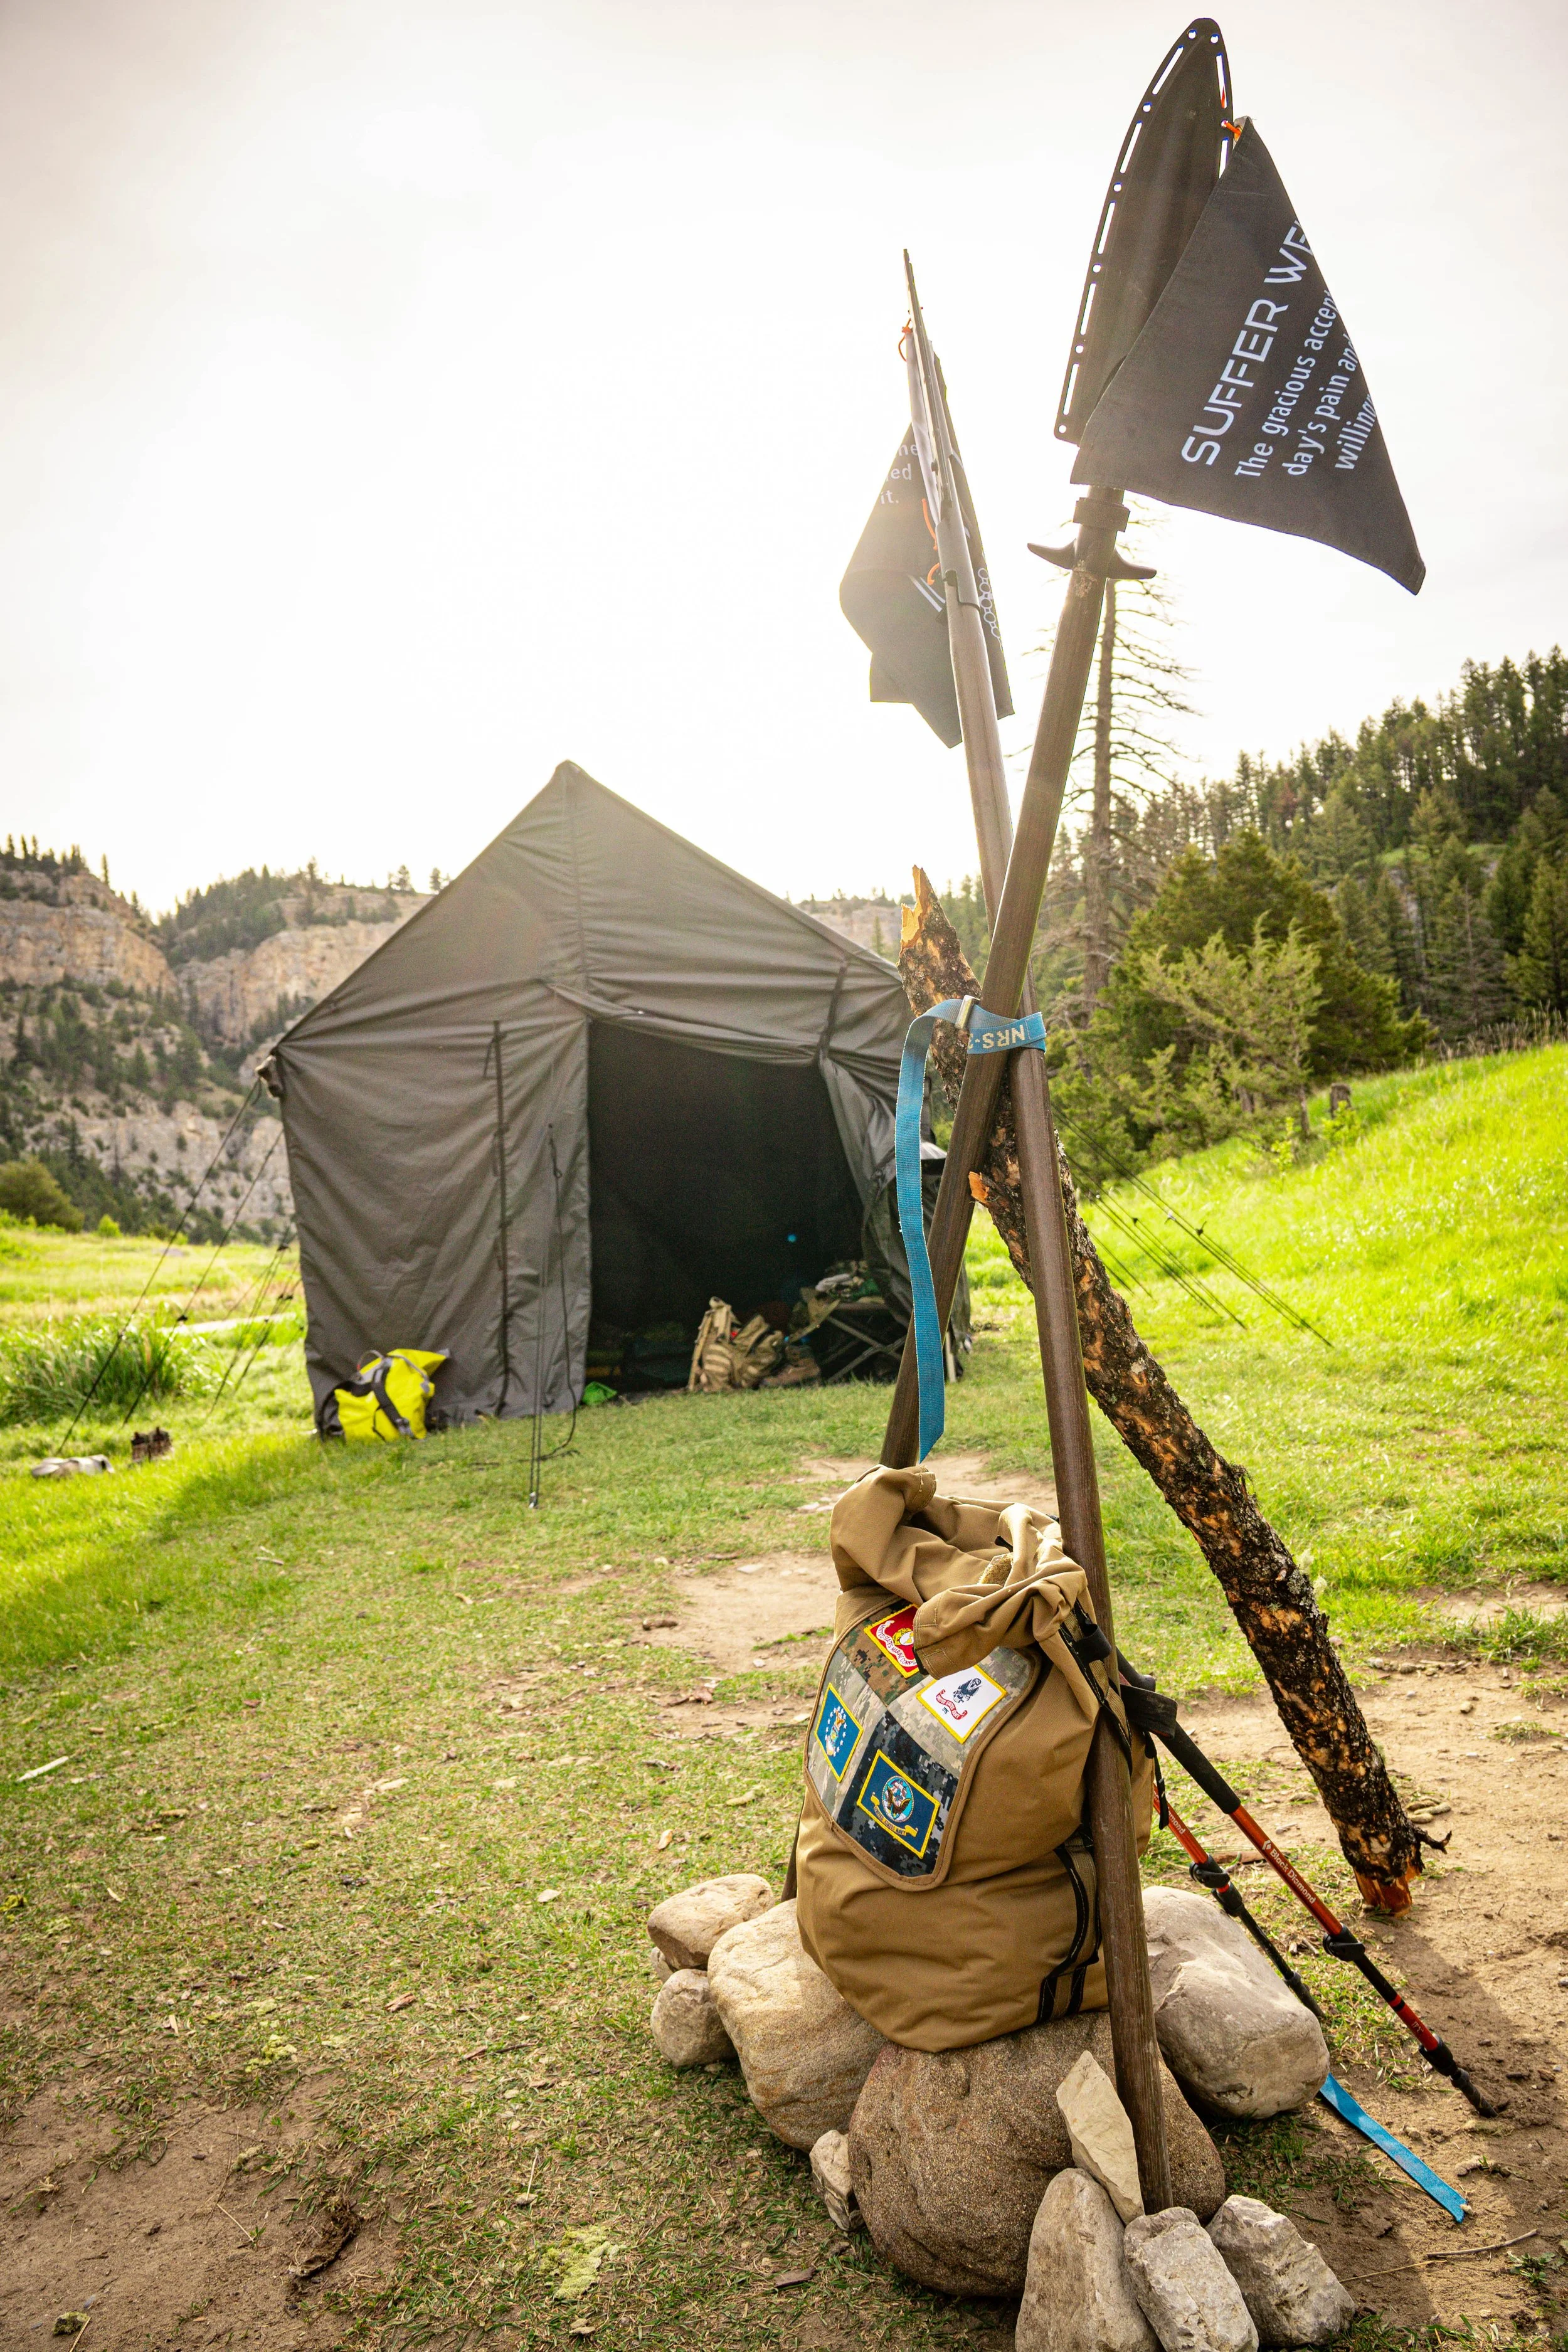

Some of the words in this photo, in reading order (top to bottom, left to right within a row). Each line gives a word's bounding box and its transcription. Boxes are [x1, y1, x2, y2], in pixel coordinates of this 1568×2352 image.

[1180, 299, 1289, 465] SUFFER
[1263, 220, 1314, 283] WE
[1234, 442, 1274, 477] The
[1262, 356, 1316, 436] gracious
[1282, 421, 1327, 476] day's
[1315, 374, 1350, 420] pain
[1269, 1848, 1289, 1872] Black
[1287, 1868, 1316, 1904] Diamond
